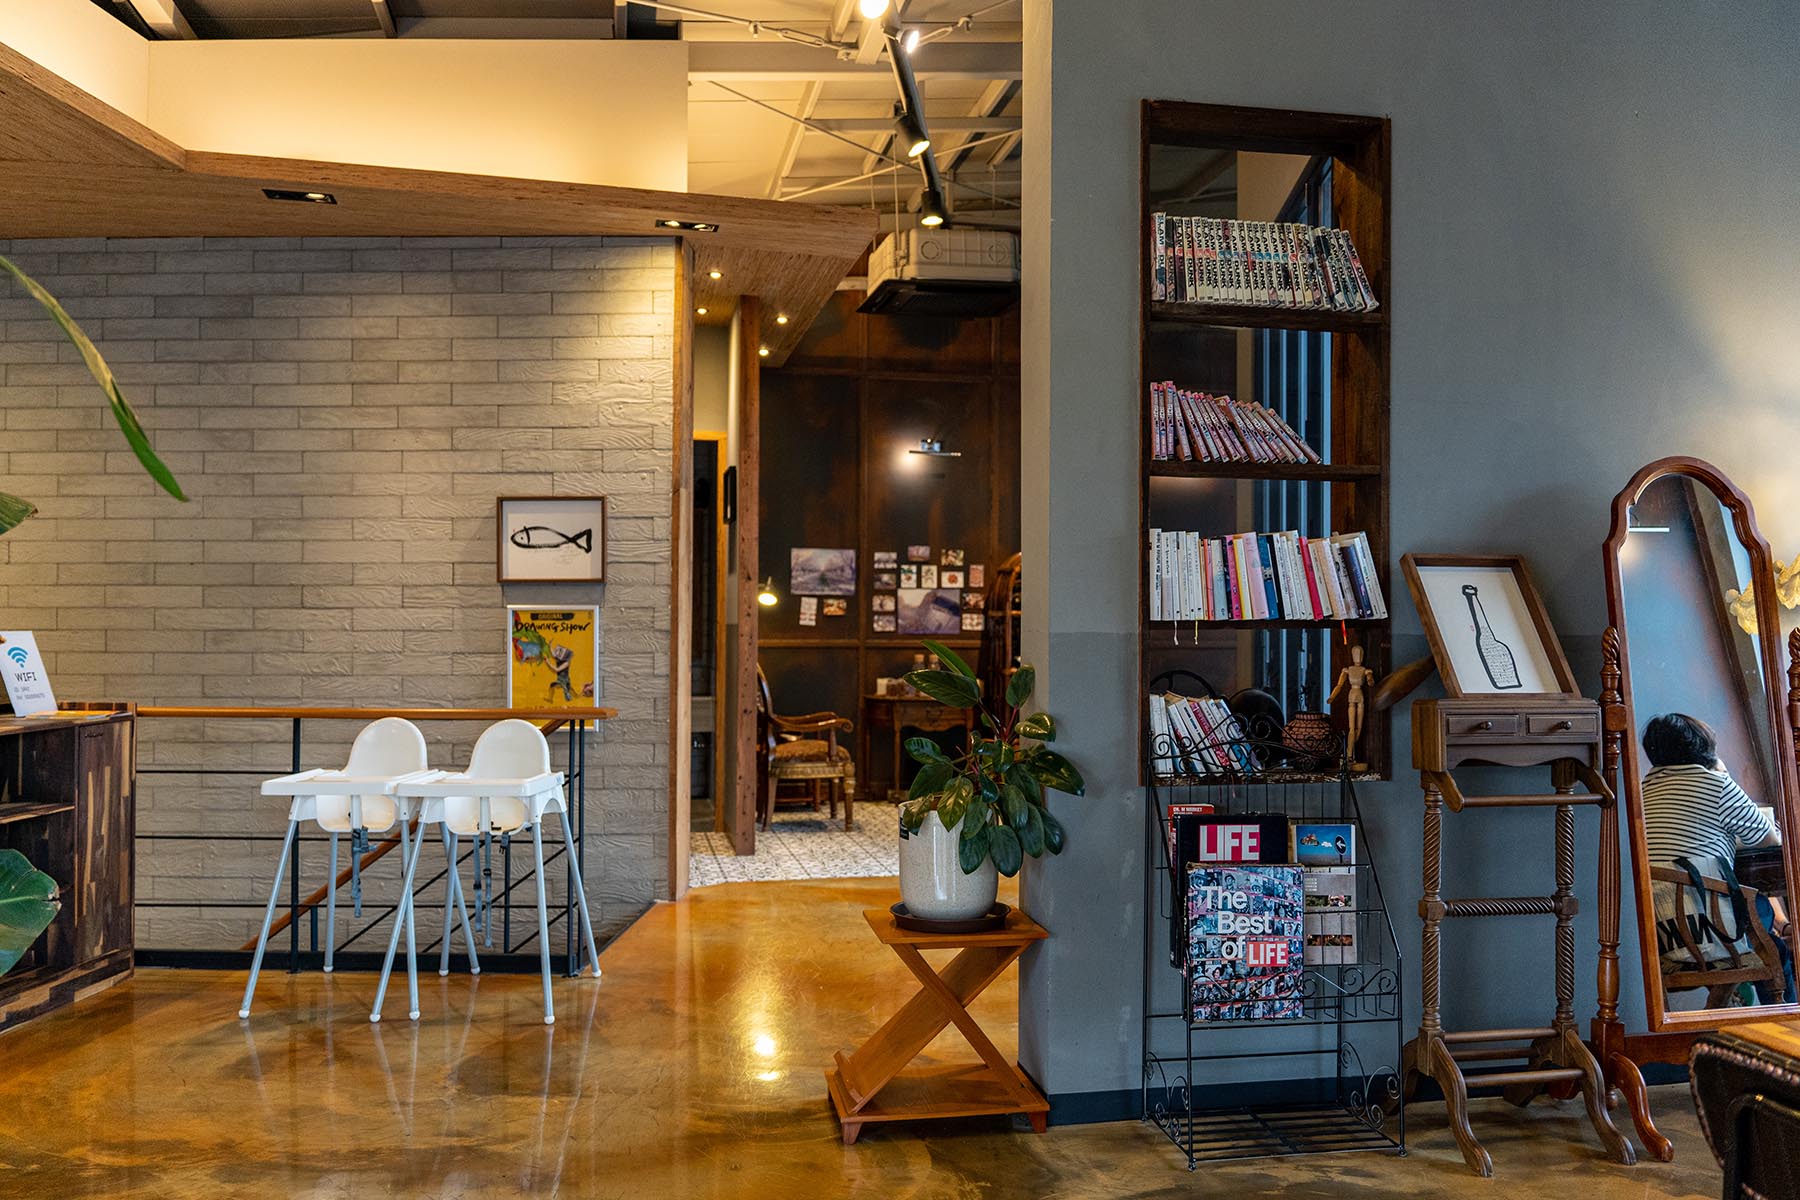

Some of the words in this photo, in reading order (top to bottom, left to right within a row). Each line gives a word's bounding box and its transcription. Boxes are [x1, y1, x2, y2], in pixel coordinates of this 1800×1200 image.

[1186, 258, 1194, 287] DUNK
[1205, 257, 1213, 286] DUNK
[1243, 261, 1251, 290] DUNK
[1258, 261, 1266, 290] DUNK
[1275, 262, 1283, 291] DUNK
[1302, 263, 1310, 292] DUNK
[14, 671, 37, 682] WIFI
[1200, 825, 1260, 861] LIFE
[1201, 886, 1248, 910] The
[1218, 911, 1273, 935] Best
[1221, 936, 1246, 960] of
[1249, 943, 1287, 965] LIFE
